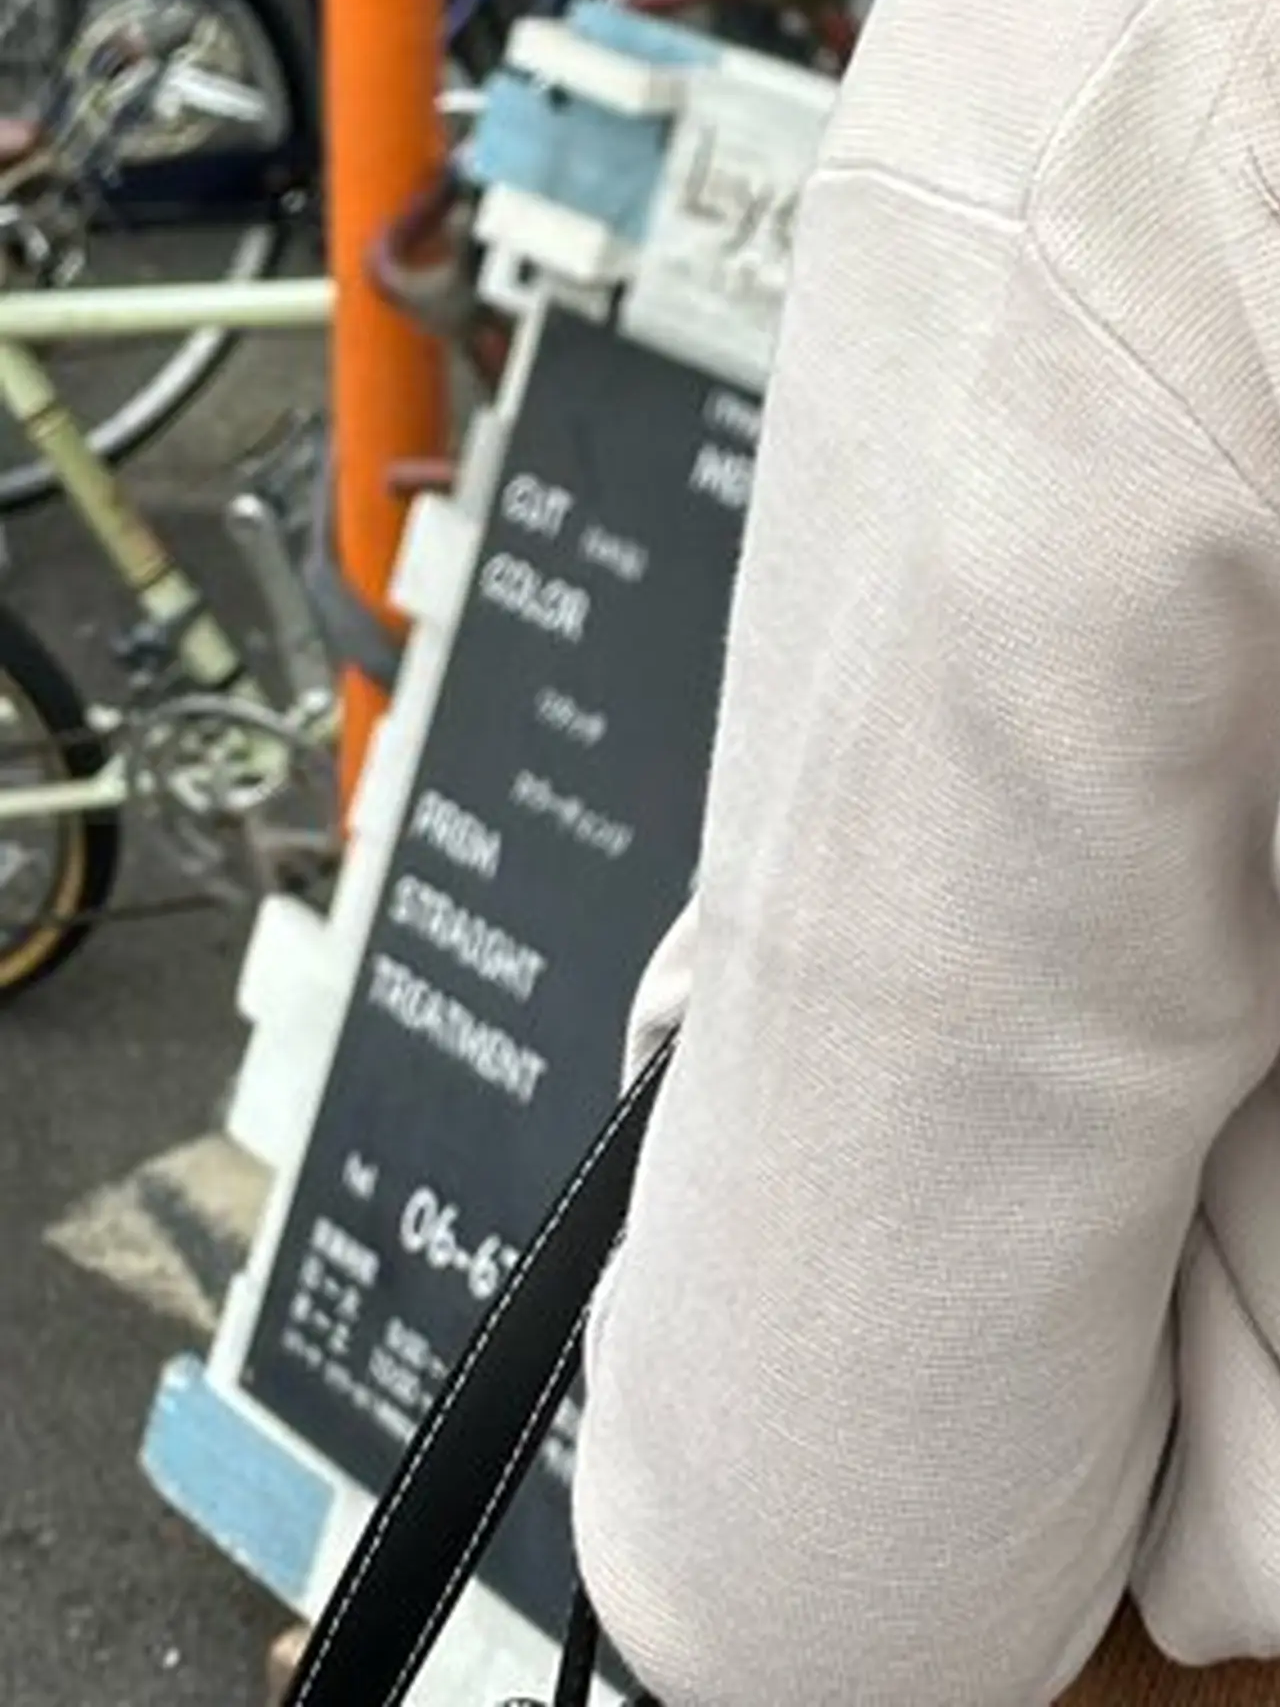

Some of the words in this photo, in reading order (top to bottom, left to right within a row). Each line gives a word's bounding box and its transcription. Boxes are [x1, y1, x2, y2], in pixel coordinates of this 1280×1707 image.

[480, 553, 592, 643] COLOR
[390, 875, 547, 1000] STRAIGHT
[369, 952, 547, 1104] TREATMENT
